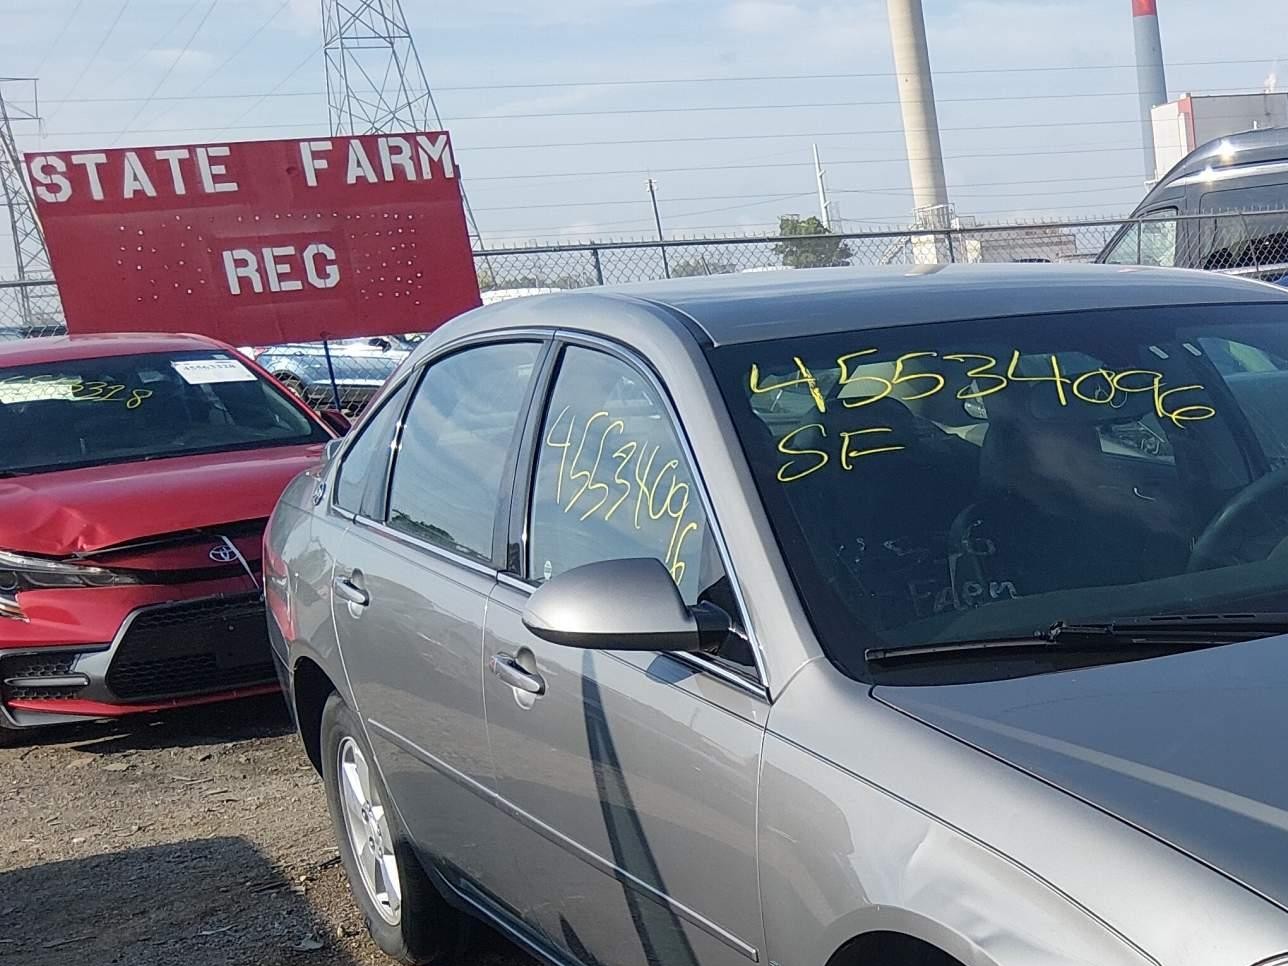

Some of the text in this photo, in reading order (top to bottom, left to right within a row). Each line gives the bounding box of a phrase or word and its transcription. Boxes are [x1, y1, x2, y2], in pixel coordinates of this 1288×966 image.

[30, 133, 455, 203] STATE FARM
[222, 243, 341, 296] REG
[750, 347, 1216, 429] 45534096
[776, 423, 906, 483] SF
